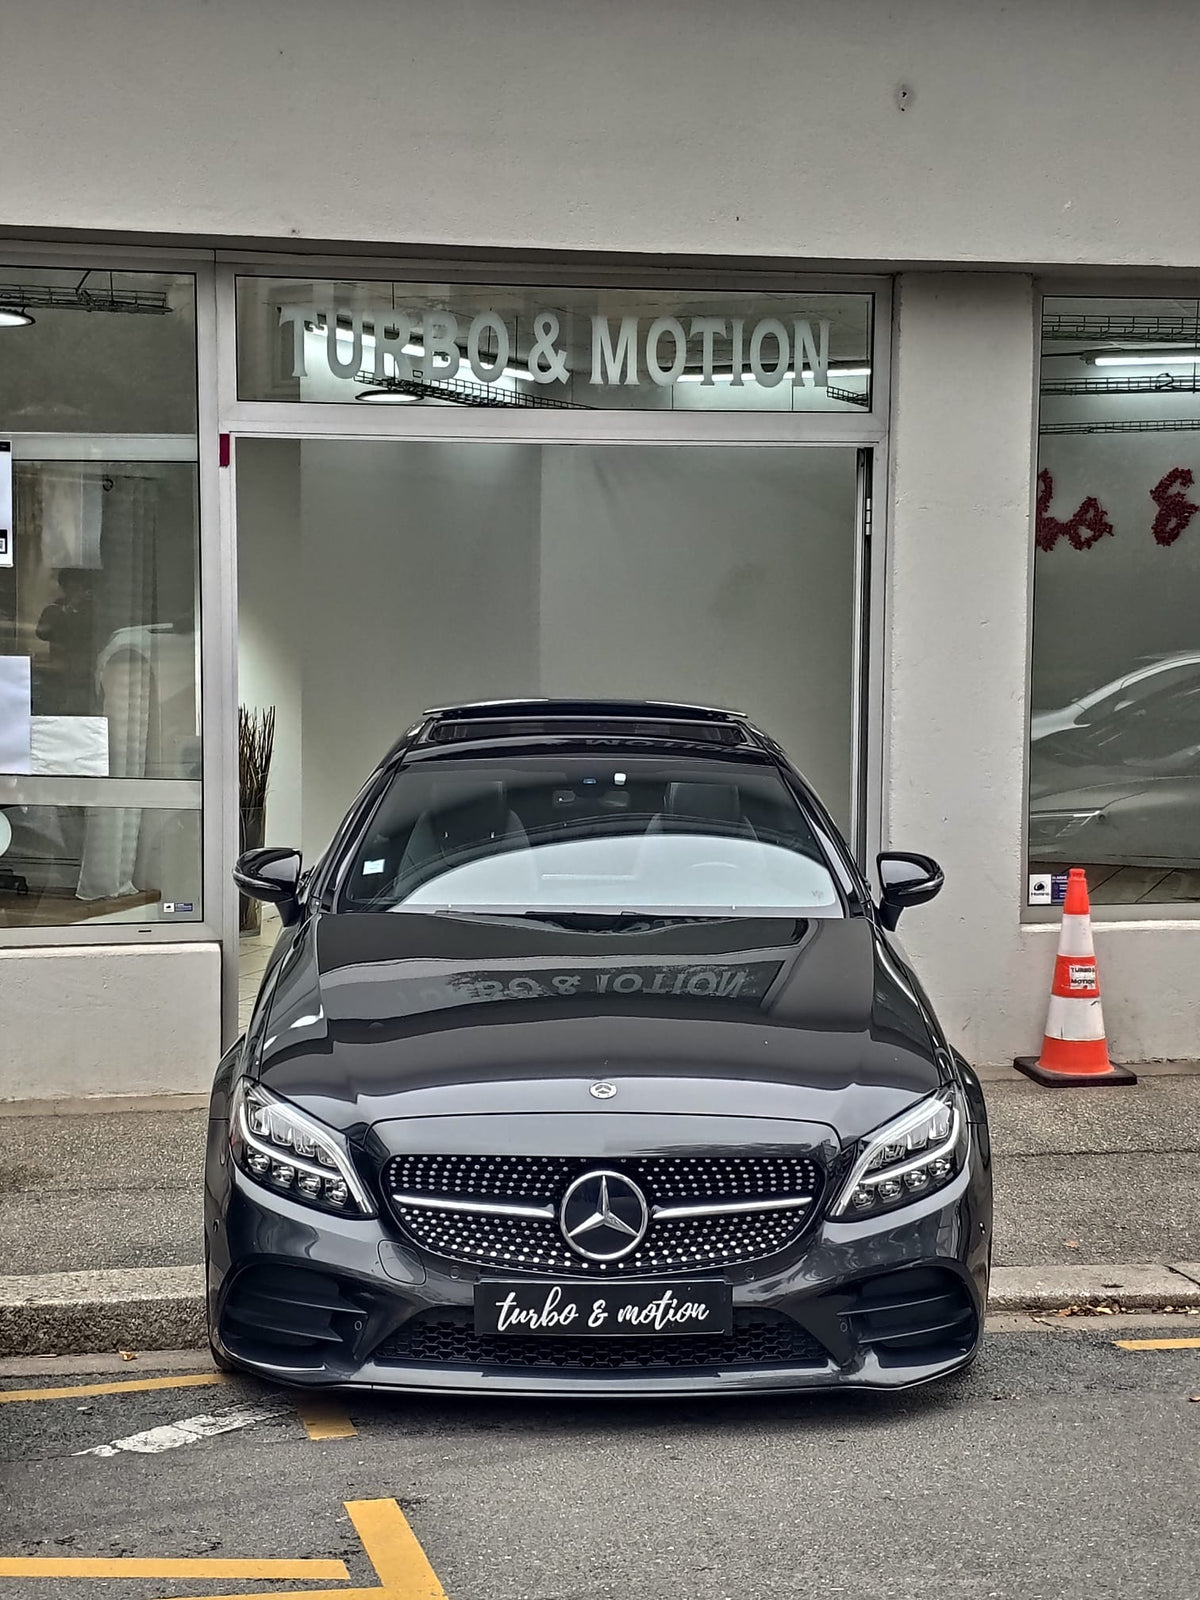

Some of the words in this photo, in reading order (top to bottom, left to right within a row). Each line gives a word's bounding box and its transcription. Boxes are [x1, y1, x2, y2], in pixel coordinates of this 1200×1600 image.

[277, 305, 509, 383] TURBO
[528, 312, 571, 384] &
[589, 315, 831, 388] MOTION
[496, 1286, 579, 1331] turbo
[587, 1299, 608, 1328] &
[617, 1290, 709, 1331] motion
